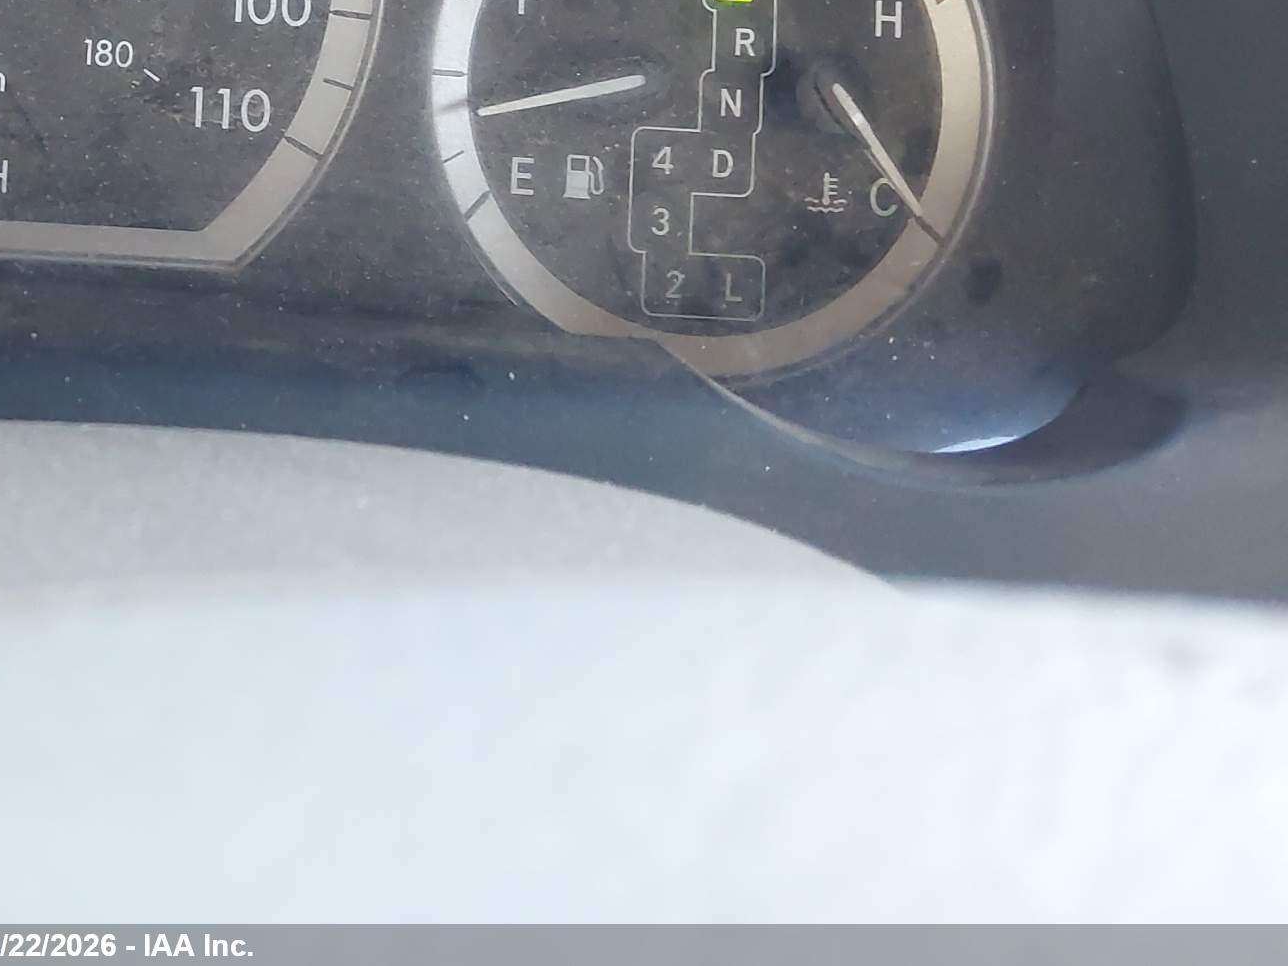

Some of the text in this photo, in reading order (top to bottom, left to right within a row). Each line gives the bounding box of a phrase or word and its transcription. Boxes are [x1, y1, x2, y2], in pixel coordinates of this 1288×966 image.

[876, 0, 902, 38] H
[85, 39, 133, 67] 180
[735, 28, 754, 56] R
[191, 87, 270, 132] 110
[721, 89, 741, 117] N
[653, 147, 673, 174] 4
[713, 150, 733, 177] D
[511, 157, 534, 195] E
[870, 177, 898, 217] C
[652, 208, 669, 235] 3
[666, 271, 685, 298] 2
[725, 273, 742, 301] L
